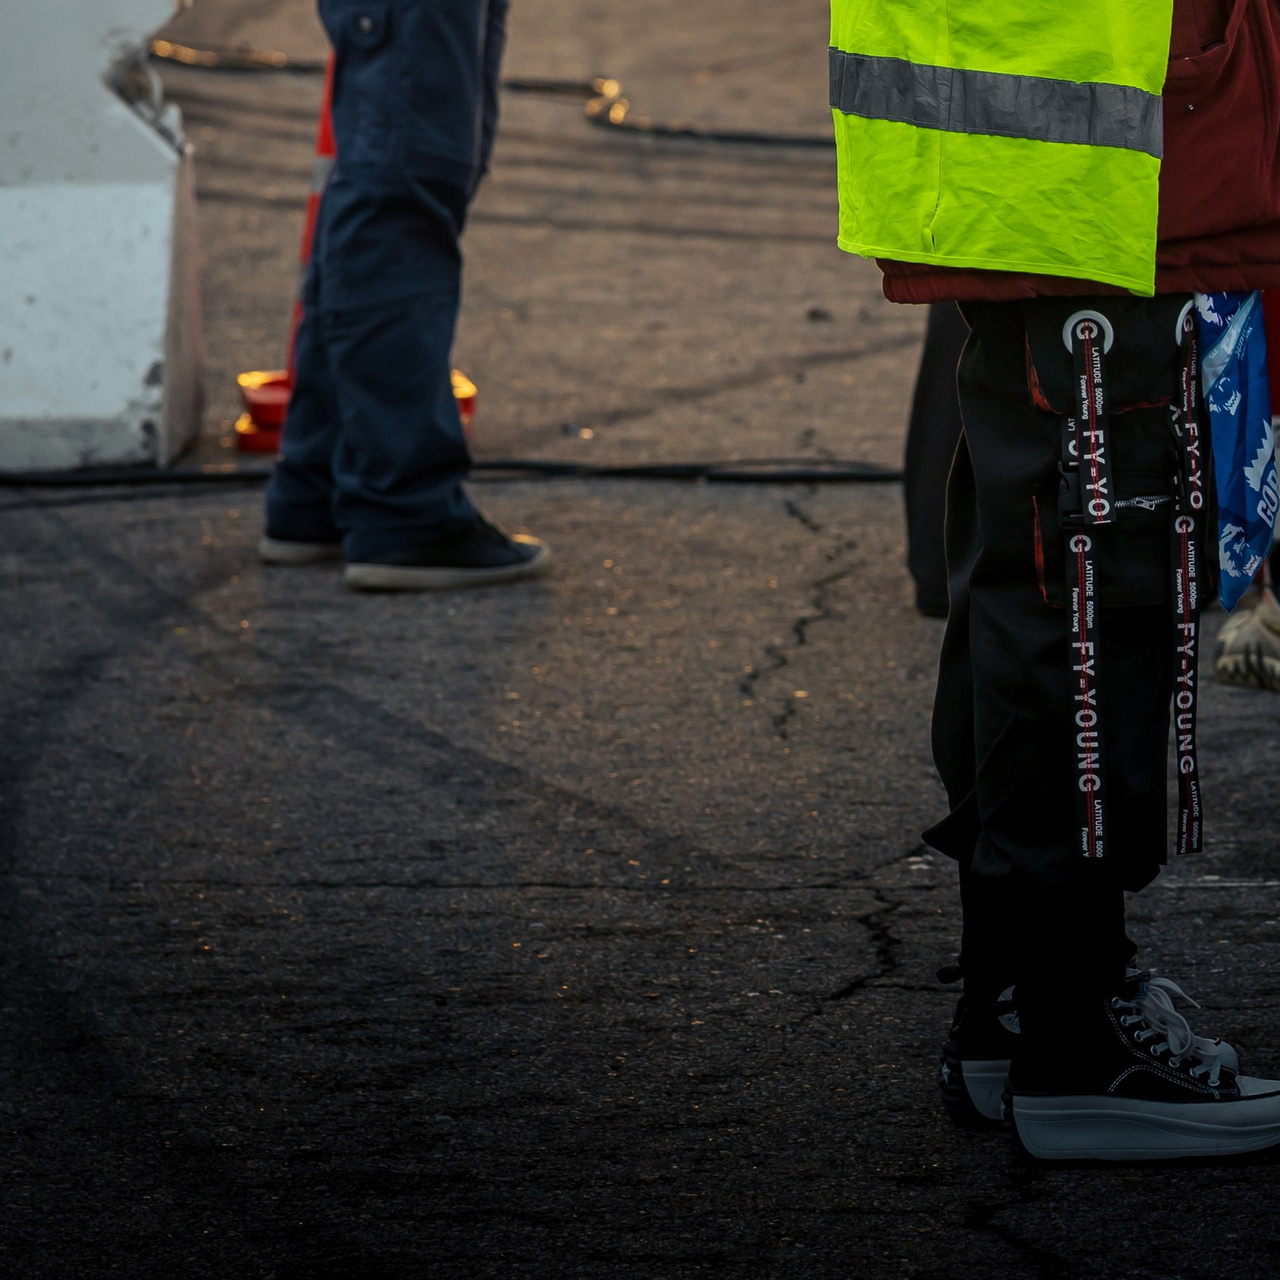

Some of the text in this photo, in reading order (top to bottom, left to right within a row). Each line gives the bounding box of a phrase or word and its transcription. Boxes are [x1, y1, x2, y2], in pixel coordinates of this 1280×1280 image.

[1076, 322, 1098, 339] G
[1092, 347, 1103, 415] LATITUDE 5000pm
[1083, 430, 1111, 524] FY-YO
[1070, 535, 1091, 552] G
[1175, 516, 1194, 533] G
[1072, 642, 1101, 792] FY-YOUNG
[1177, 623, 1195, 774] FY-YOUNG
[1191, 781, 1200, 817] LATITUDE
